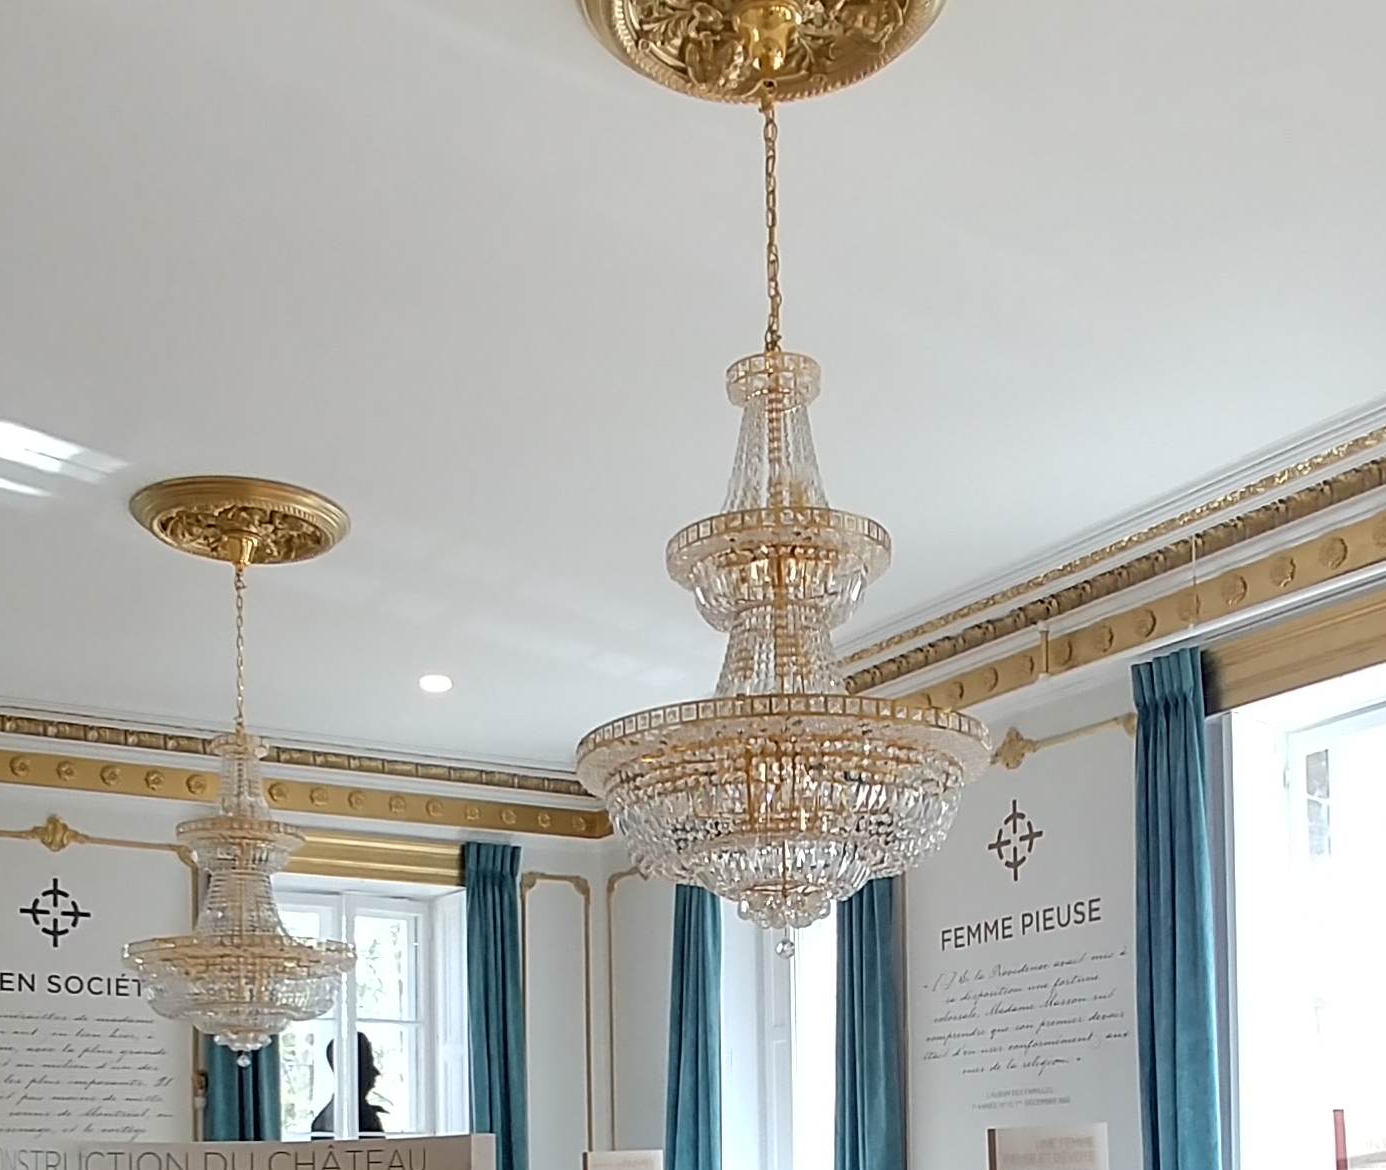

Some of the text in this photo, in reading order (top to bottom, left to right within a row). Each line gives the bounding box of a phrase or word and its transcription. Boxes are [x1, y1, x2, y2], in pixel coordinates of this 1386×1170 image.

[941, 897, 1102, 951] FEMME PIEUSE
[0, 972, 35, 992] EN
[47, 973, 143, 997] SOCIÉT
